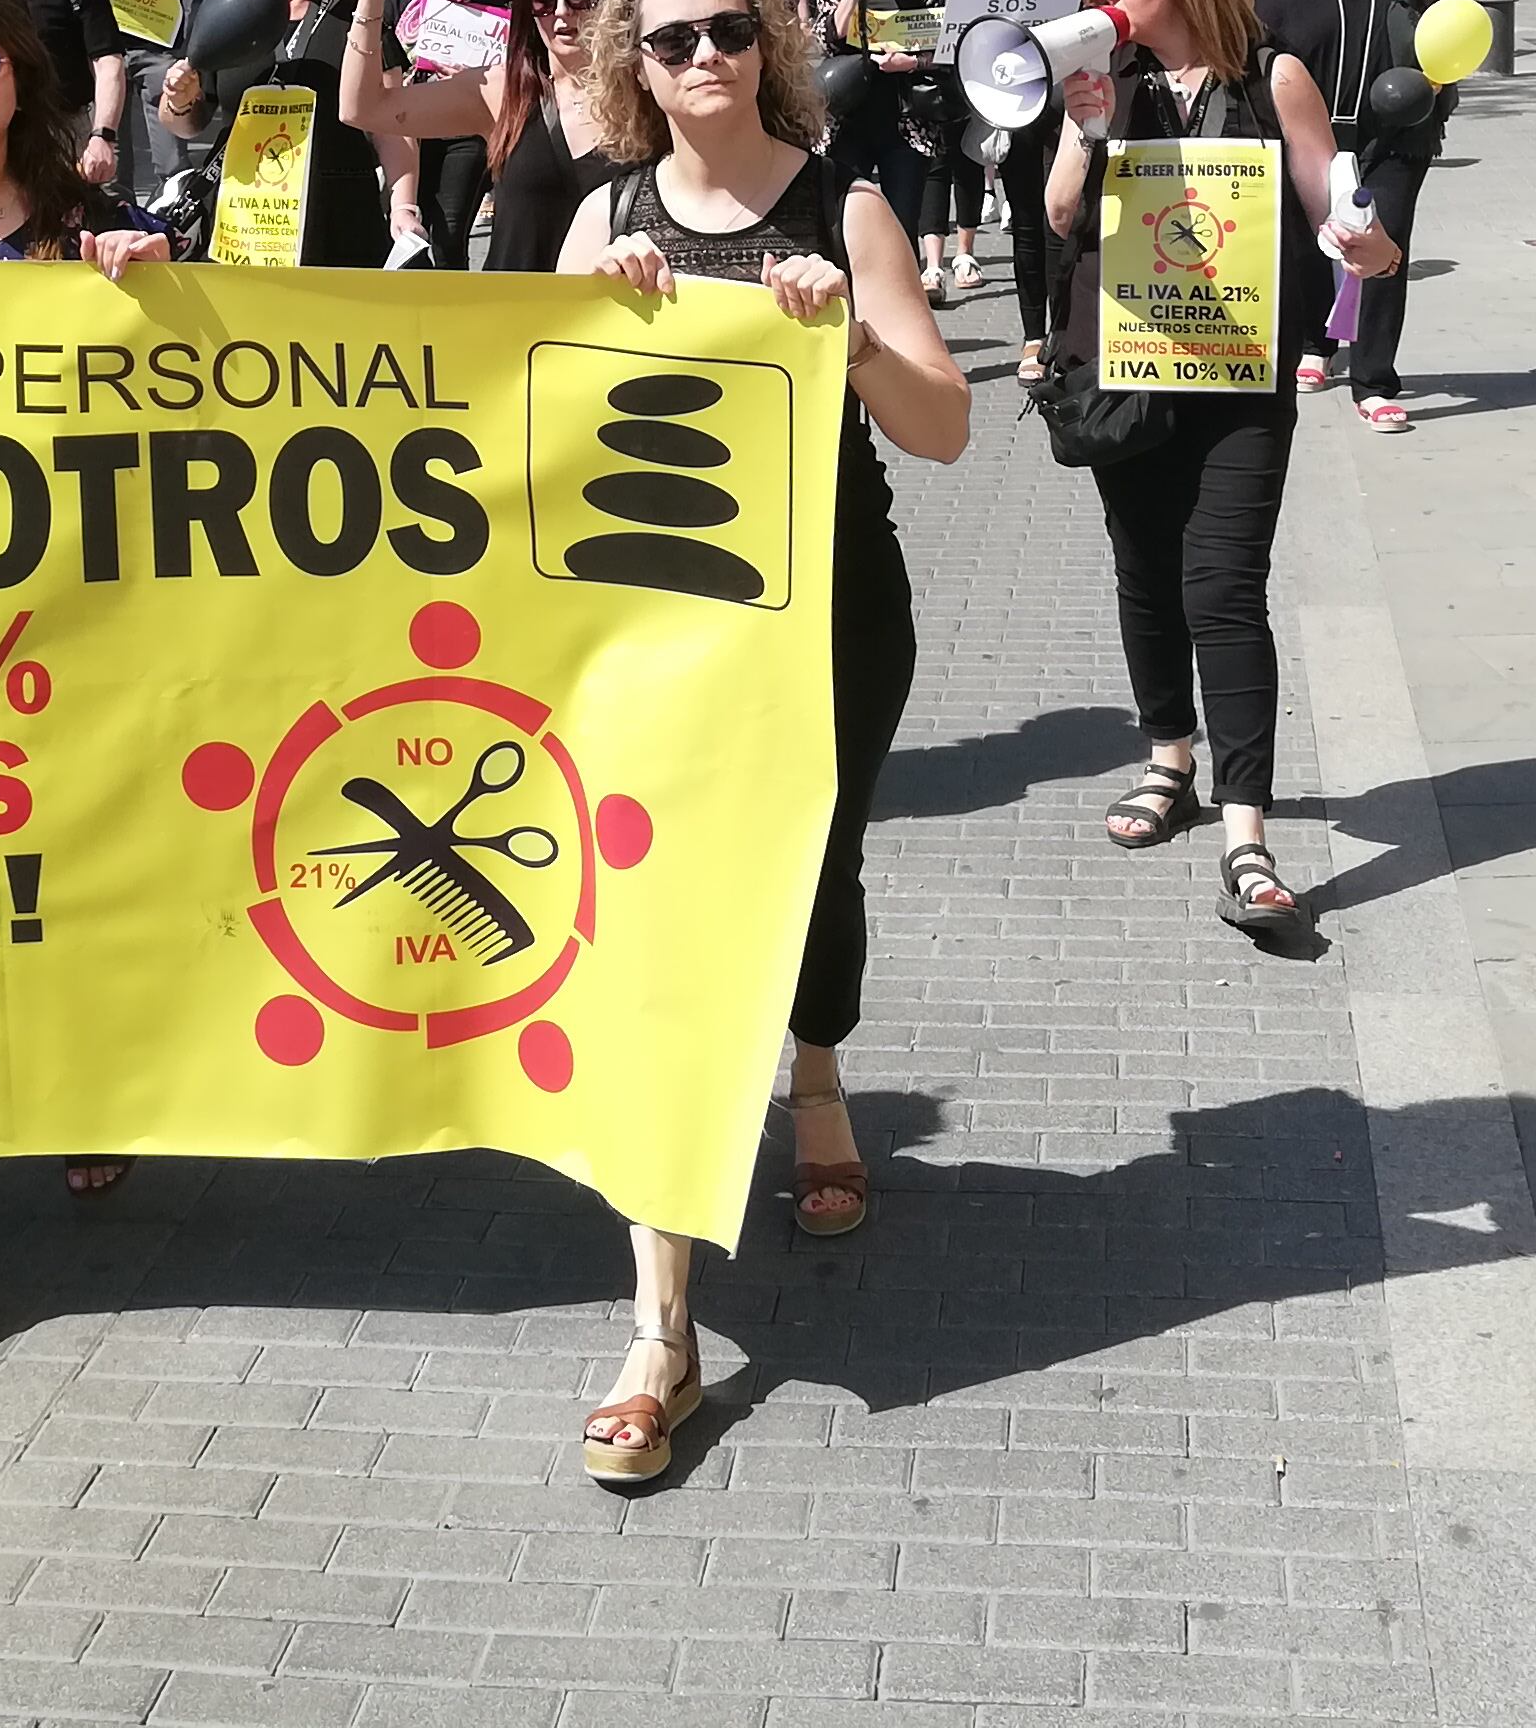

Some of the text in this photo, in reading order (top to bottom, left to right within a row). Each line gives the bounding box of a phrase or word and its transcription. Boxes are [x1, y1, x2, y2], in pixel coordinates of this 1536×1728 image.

[419, 39, 454, 55] SOS
[1135, 163, 1266, 178] CREER EN NOSOTROS
[273, 198, 289, 210] UN
[254, 241, 298, 252] ESSENCIA
[1116, 284, 1261, 303] EL IVA AL 21%
[1150, 304, 1227, 321] CIERRA
[1118, 322, 1258, 336] NUESTROS CENTROS
[1108, 340, 1267, 358] ¡SOMOS ESENCIALES!
[1109, 360, 1266, 382] ¡IVA 10% YA!
[397, 737, 454, 766] NO
[289, 863, 356, 890] 21%
[395, 934, 457, 965] IVA
